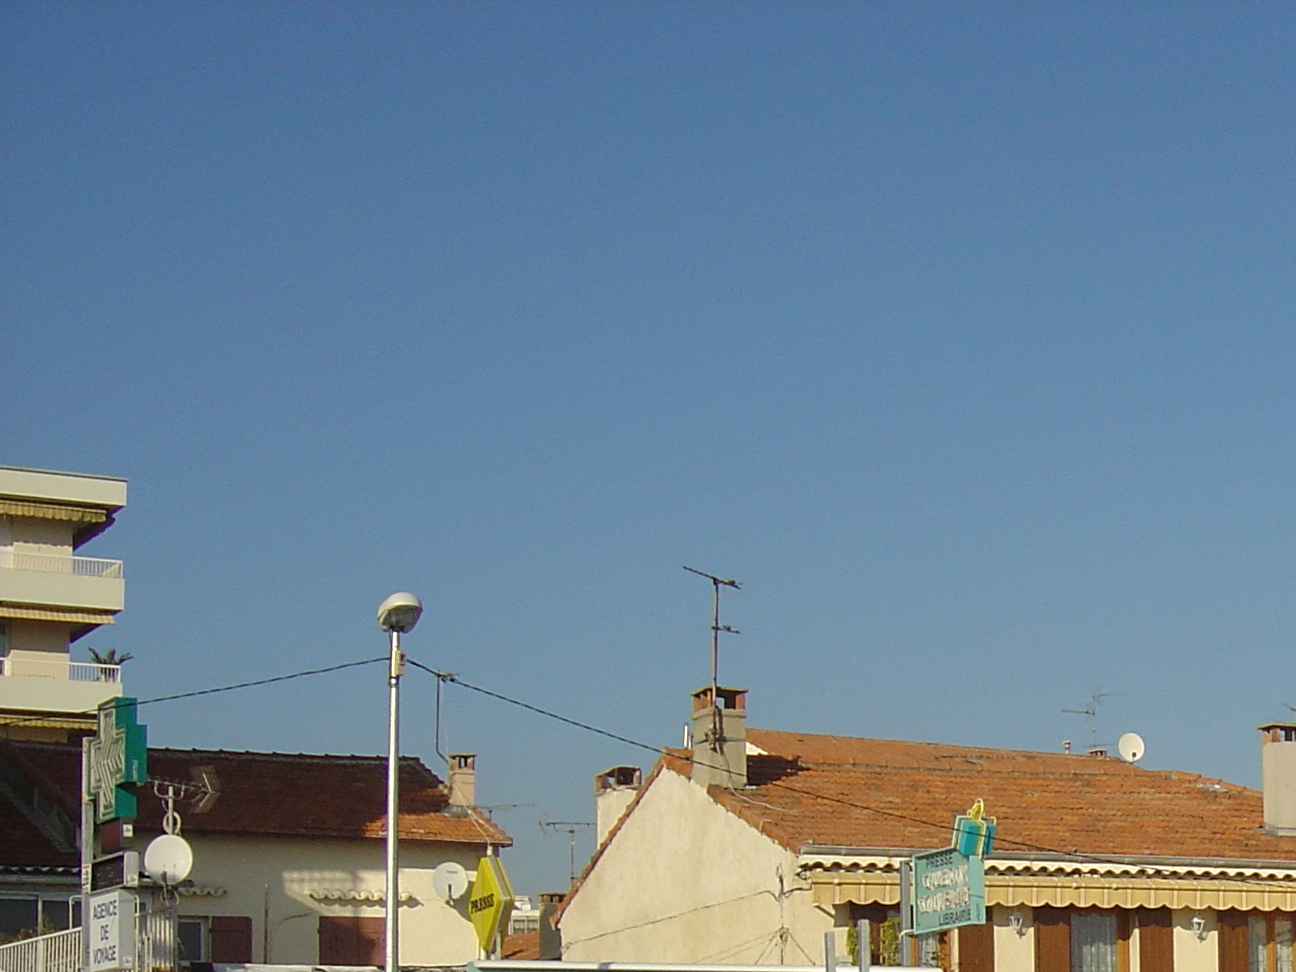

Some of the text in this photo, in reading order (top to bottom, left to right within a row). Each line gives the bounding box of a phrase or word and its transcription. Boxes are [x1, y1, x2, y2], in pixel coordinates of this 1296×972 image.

[93, 899, 117, 920] AGENCE
[100, 924, 109, 941] DE
[93, 944, 117, 964] VOYAGE
